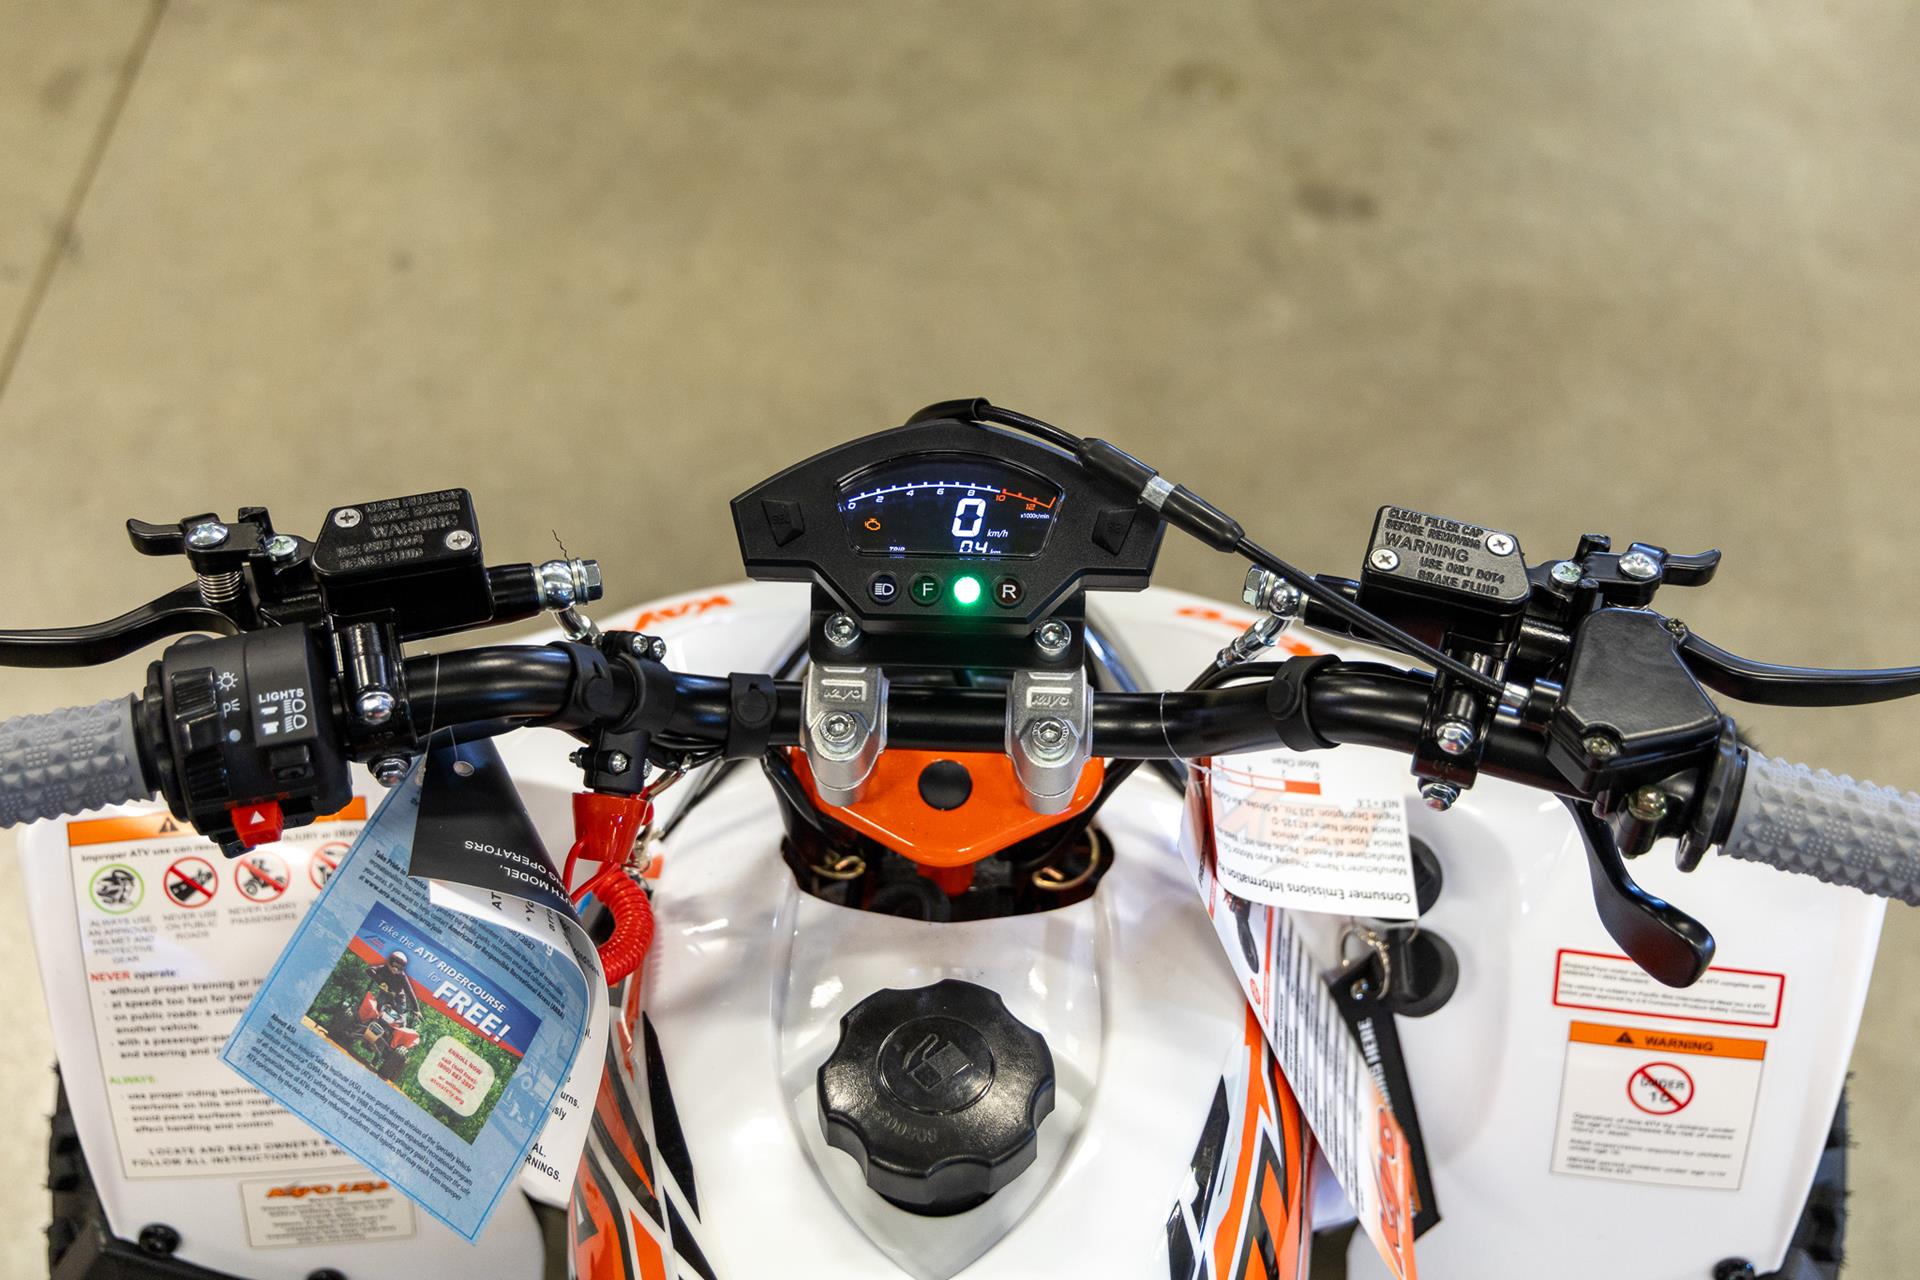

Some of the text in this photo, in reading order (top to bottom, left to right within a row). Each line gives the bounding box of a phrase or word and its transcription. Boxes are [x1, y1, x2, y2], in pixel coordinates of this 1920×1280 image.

[952, 498, 1008, 538] 0 km/h
[1387, 508, 1484, 538] CLEAN FILLER CAP
[1385, 518, 1481, 550] BEFORE REMOVING
[1384, 531, 1469, 563] WARNING
[1419, 556, 1444, 571] USE
[1445, 562, 1473, 578] ONLY
[922, 583, 934, 596] F
[1002, 584, 1016, 599] R
[1417, 569, 1499, 596] BRAKE FLUID
[258, 688, 305, 704] LIGHTS
[464, 839, 547, 874] OPERATORS
[500, 864, 549, 892] MODEL,
[1285, 881, 1345, 898] Emissions
[1347, 887, 1411, 904] Consumer
[90, 971, 131, 981] NEVER
[376, 918, 506, 1014] Take the ATV RIDERCOURSE
[270, 1012, 288, 1028] About
[431, 982, 511, 1044] FREE!
[1644, 1035, 1714, 1052] WARNING
